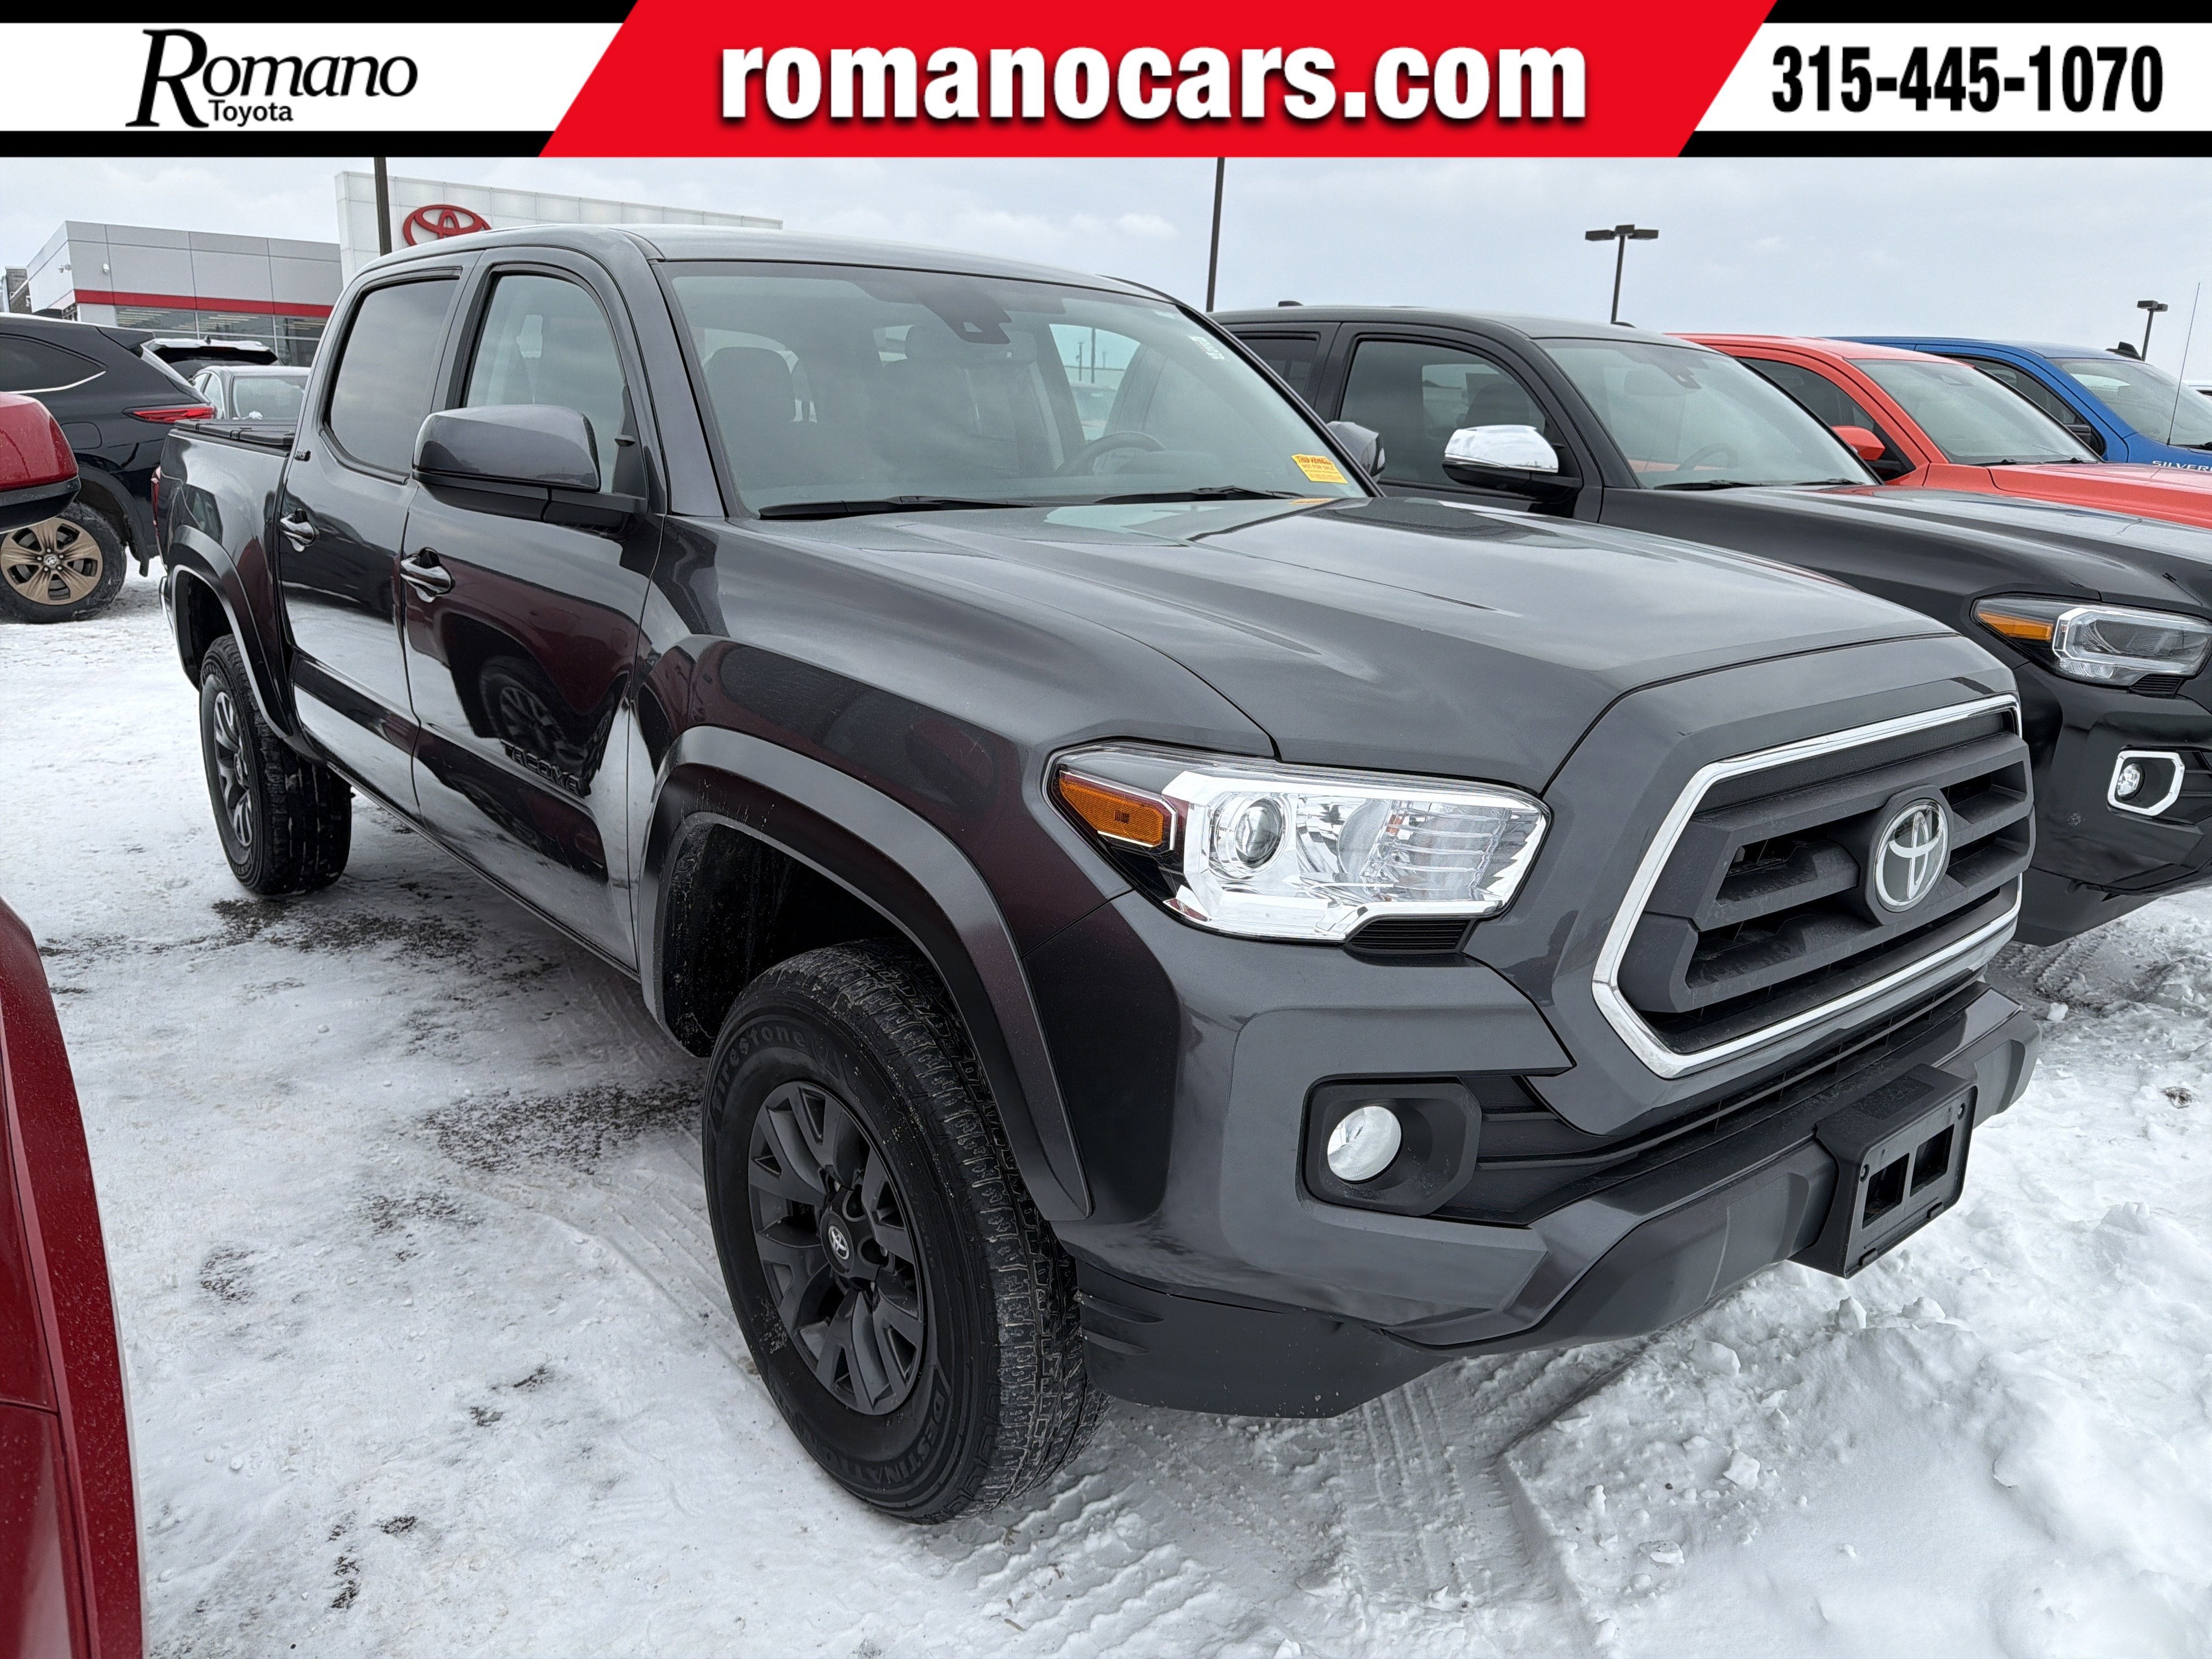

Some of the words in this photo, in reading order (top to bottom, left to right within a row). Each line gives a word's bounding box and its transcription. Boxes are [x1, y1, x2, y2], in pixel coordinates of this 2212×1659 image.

[2152, 460, 2212, 472] SILVER
[500, 738, 585, 798] TACOMA
[712, 1026, 806, 1115] Firestone
